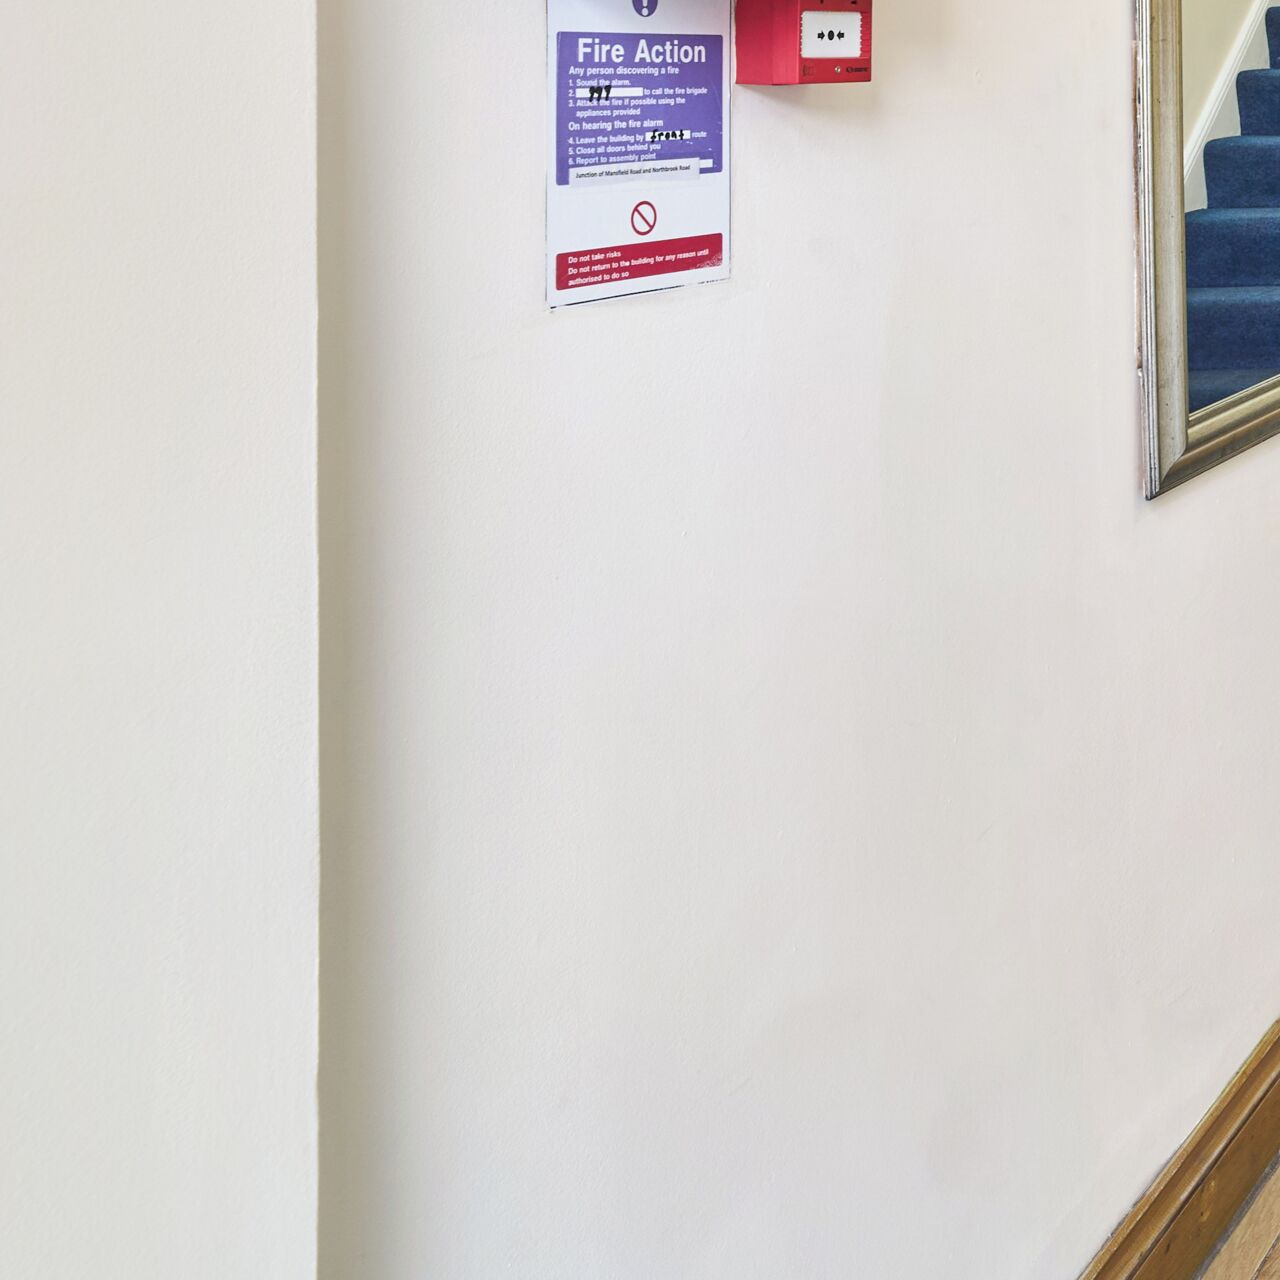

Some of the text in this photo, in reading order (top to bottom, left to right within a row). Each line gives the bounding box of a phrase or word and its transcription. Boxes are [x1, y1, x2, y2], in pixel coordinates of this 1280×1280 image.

[578, 38, 706, 63] Fire Action
[569, 66, 584, 76] Any
[587, 67, 614, 76] person
[616, 66, 659, 76] discovering
[631, 98, 656, 106] possible
[569, 122, 580, 131] On
[583, 121, 612, 131] hearing
[614, 121, 627, 129] the
[629, 120, 641, 128] fire
[636, 135, 644, 143] by
[650, 129, 684, 144] front
[609, 155, 639, 163] assembly
[568, 256, 578, 264] Do
[631, 257, 654, 266] building
[665, 254, 675, 262] any
[568, 277, 602, 286] authorised
